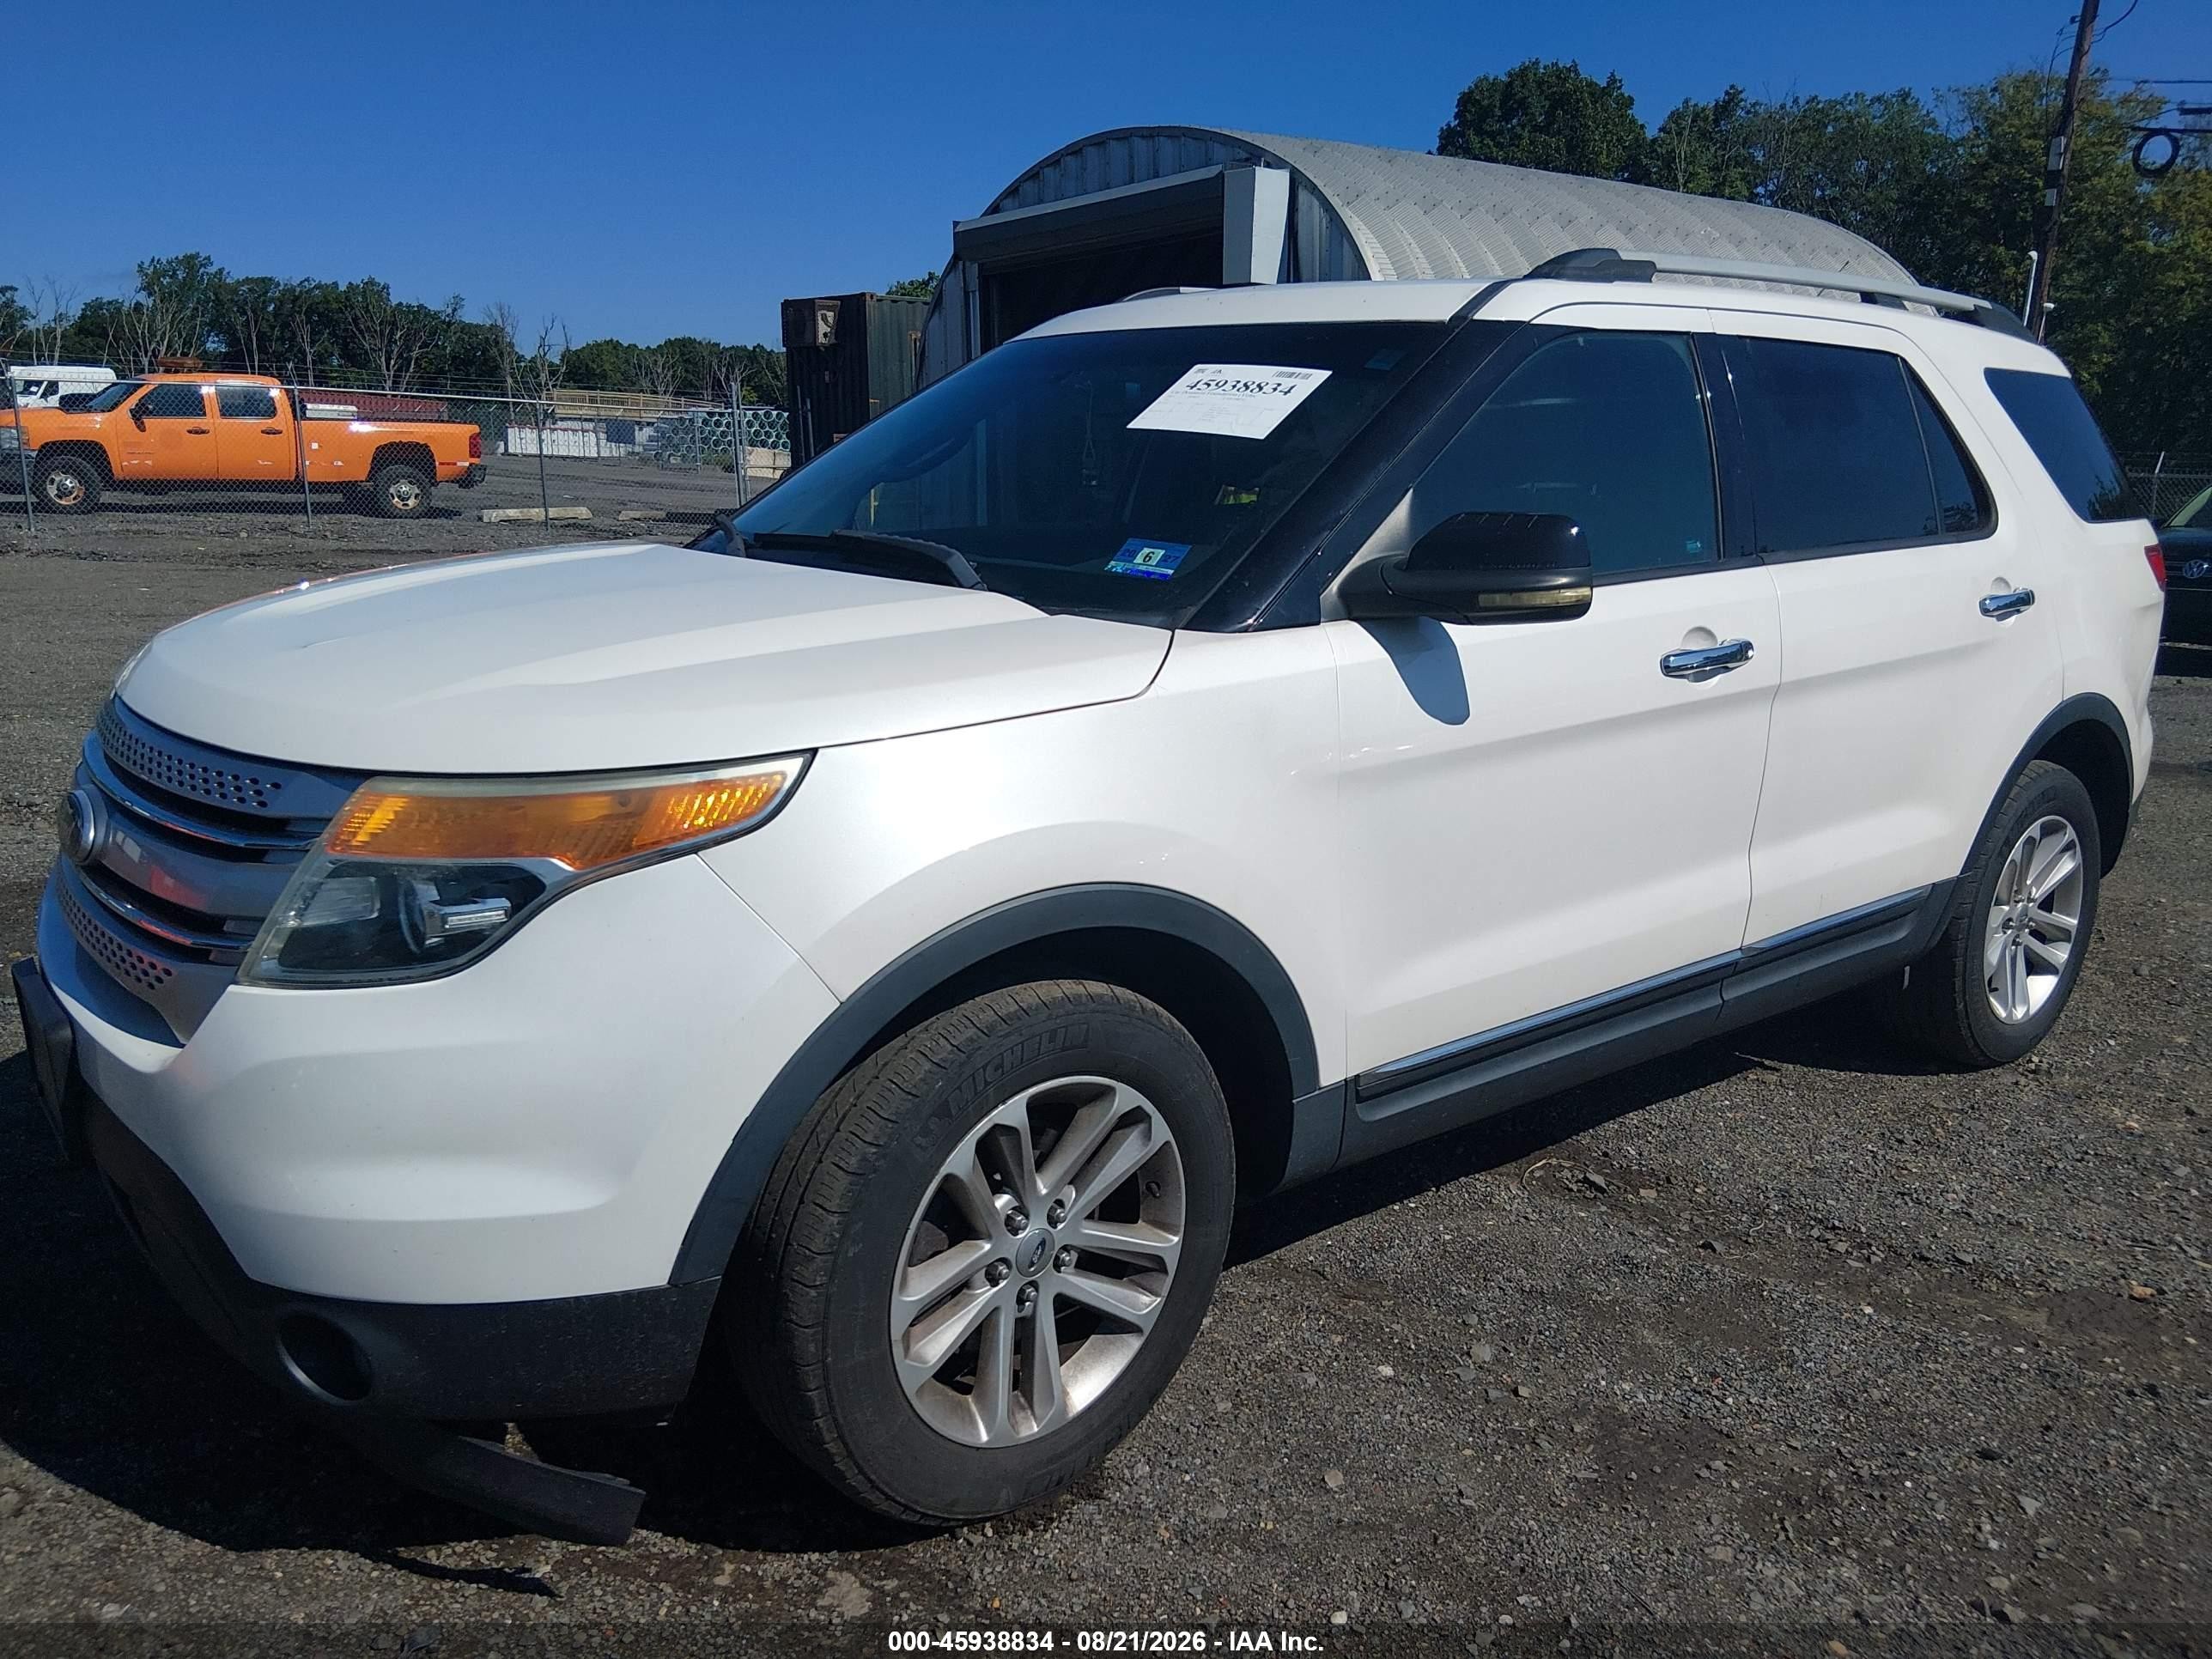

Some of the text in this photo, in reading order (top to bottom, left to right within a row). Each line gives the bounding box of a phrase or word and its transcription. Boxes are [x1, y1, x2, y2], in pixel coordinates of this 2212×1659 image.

[1186, 378, 1297, 396] 45938834
[1142, 551, 1155, 563] 6
[946, 1023, 1090, 1117] MICHELIN
